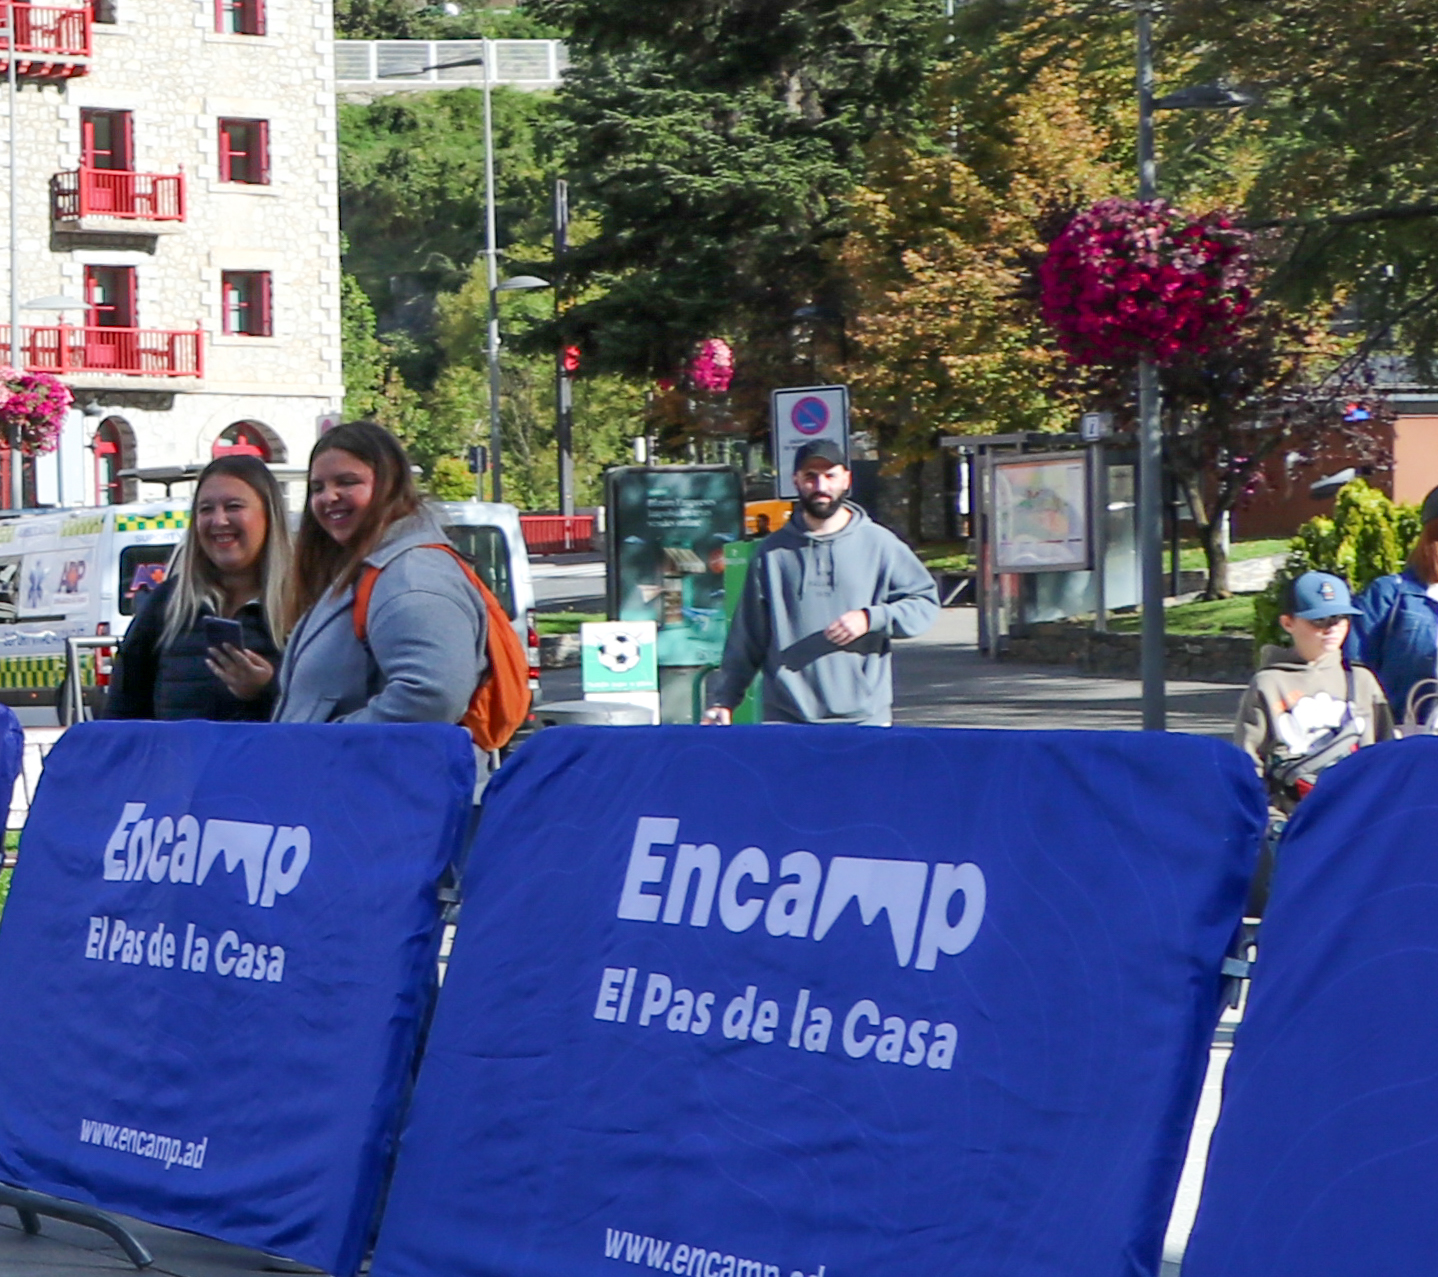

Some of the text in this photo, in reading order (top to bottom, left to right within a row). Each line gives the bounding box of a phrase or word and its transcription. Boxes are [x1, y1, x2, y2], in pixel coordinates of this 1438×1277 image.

[103, 802, 312, 908] Encamp
[616, 816, 988, 972] Encamp
[85, 915, 286, 983] El Pas de la Casa
[593, 967, 959, 1070] El Pas de la Casa
[80, 1118, 208, 1171] www.encamp.ad
